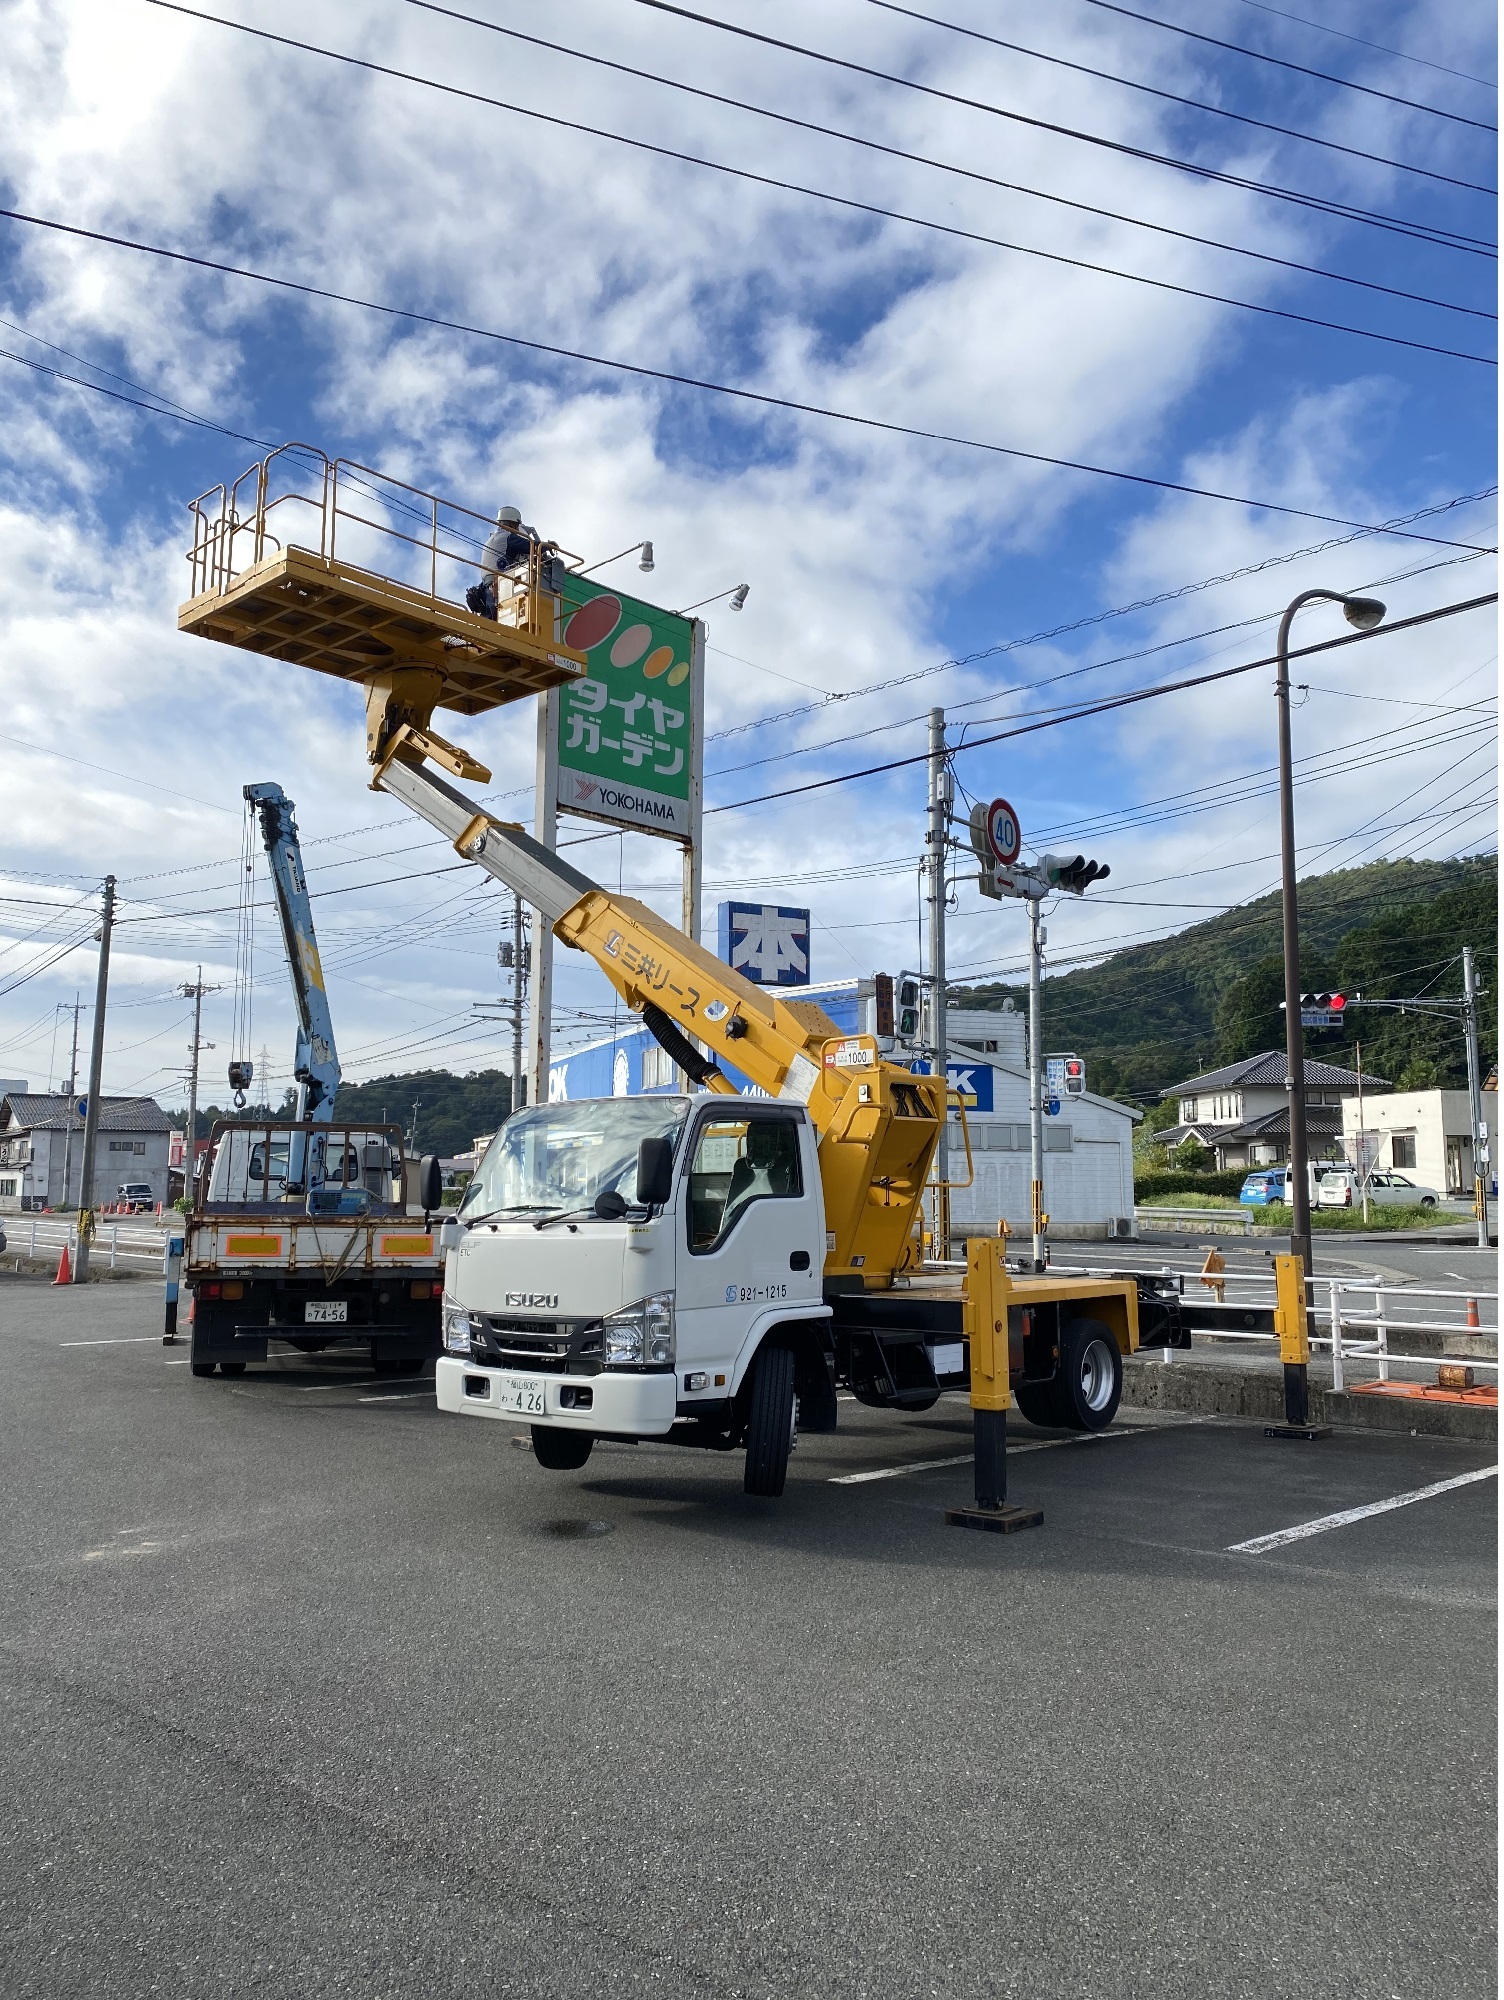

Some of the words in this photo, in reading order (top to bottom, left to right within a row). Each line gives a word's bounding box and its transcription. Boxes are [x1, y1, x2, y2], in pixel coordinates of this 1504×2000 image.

[567, 677, 685, 735] タイヤ
[566, 713, 684, 775] ガーデン
[599, 786, 676, 821] YOKOHAMA
[996, 816, 1013, 848] 40
[732, 906, 807, 982] 本
[620, 943, 700, 1018] 三共リース
[848, 1051, 867, 1064] 1000
[460, 1241, 481, 1249] ELF
[460, 1249, 471, 1257] ETC
[505, 1291, 559, 1309] ISUZU
[740, 1285, 787, 1301] 921-1215
[314, 1309, 345, 1321] 74-56
